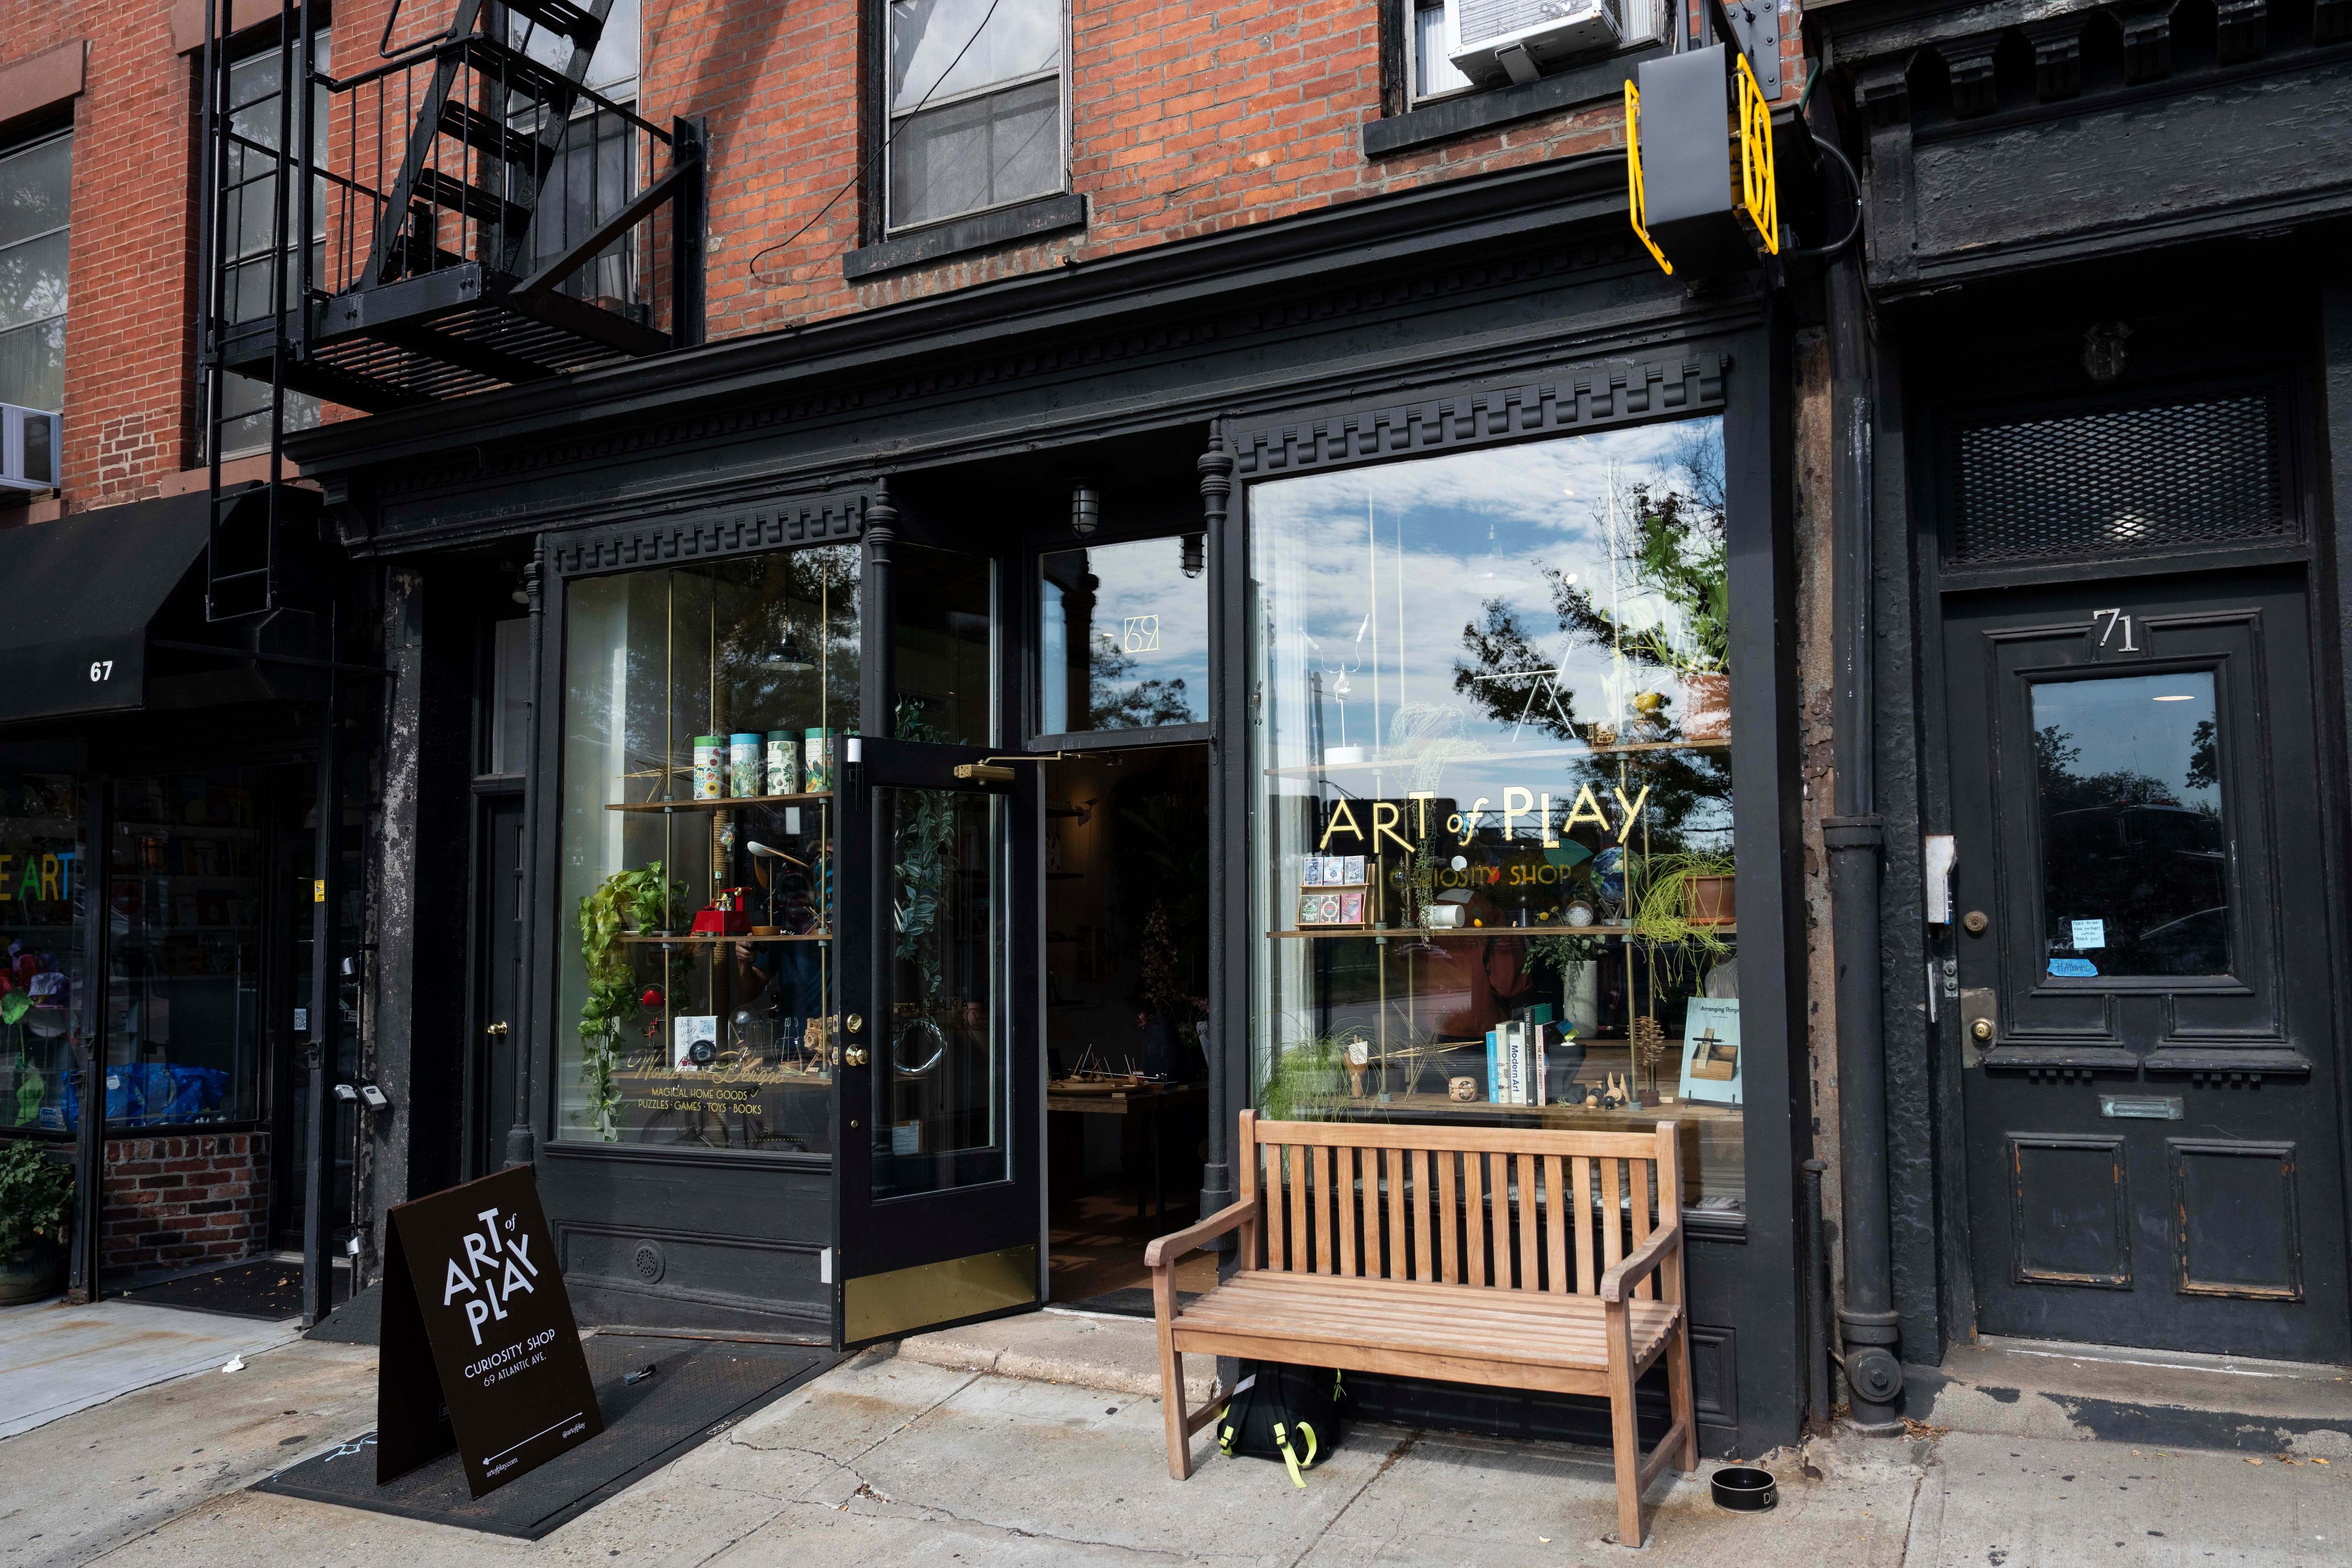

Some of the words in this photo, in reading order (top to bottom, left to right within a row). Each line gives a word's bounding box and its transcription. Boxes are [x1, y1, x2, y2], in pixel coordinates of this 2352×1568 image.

[1125, 615, 1159, 653] 69
[2093, 608, 2139, 652] 71
[90, 661, 113, 682] 67
[1319, 791, 1435, 855] ART
[1446, 797, 1490, 847] of
[1503, 782, 1649, 849] PLAY
[18, 852, 75, 901] ART
[1389, 866, 1499, 889] CURIOSITY
[1509, 864, 1571, 886] SHOP
[2064, 963, 2091, 972] Atlantic
[628, 1048, 693, 1081] Wonder
[712, 1051, 784, 1097] Design
[638, 1099, 668, 1109] PUZZLES
[675, 1101, 701, 1111] GAMES
[707, 1103, 726, 1113] TOYS
[733, 1104, 762, 1114] BOOKS
[652, 1087, 688, 1098] MAGICAL
[691, 1089, 714, 1099] HOME
[716, 1090, 747, 1100] GOODS
[444, 1207, 502, 1305] ART
[505, 1213, 516, 1231] of
[465, 1234, 539, 1346] PLAY
[465, 1342, 522, 1378] CURIOSITY
[527, 1329, 555, 1351] SHOP
[484, 1375, 495, 1386] 69
[499, 1358, 530, 1381] ATLANTIC
[532, 1352, 547, 1365] AVE.
[562, 1422, 585, 1438] @artofplay
[486, 1457, 518, 1477] artofplay.com
